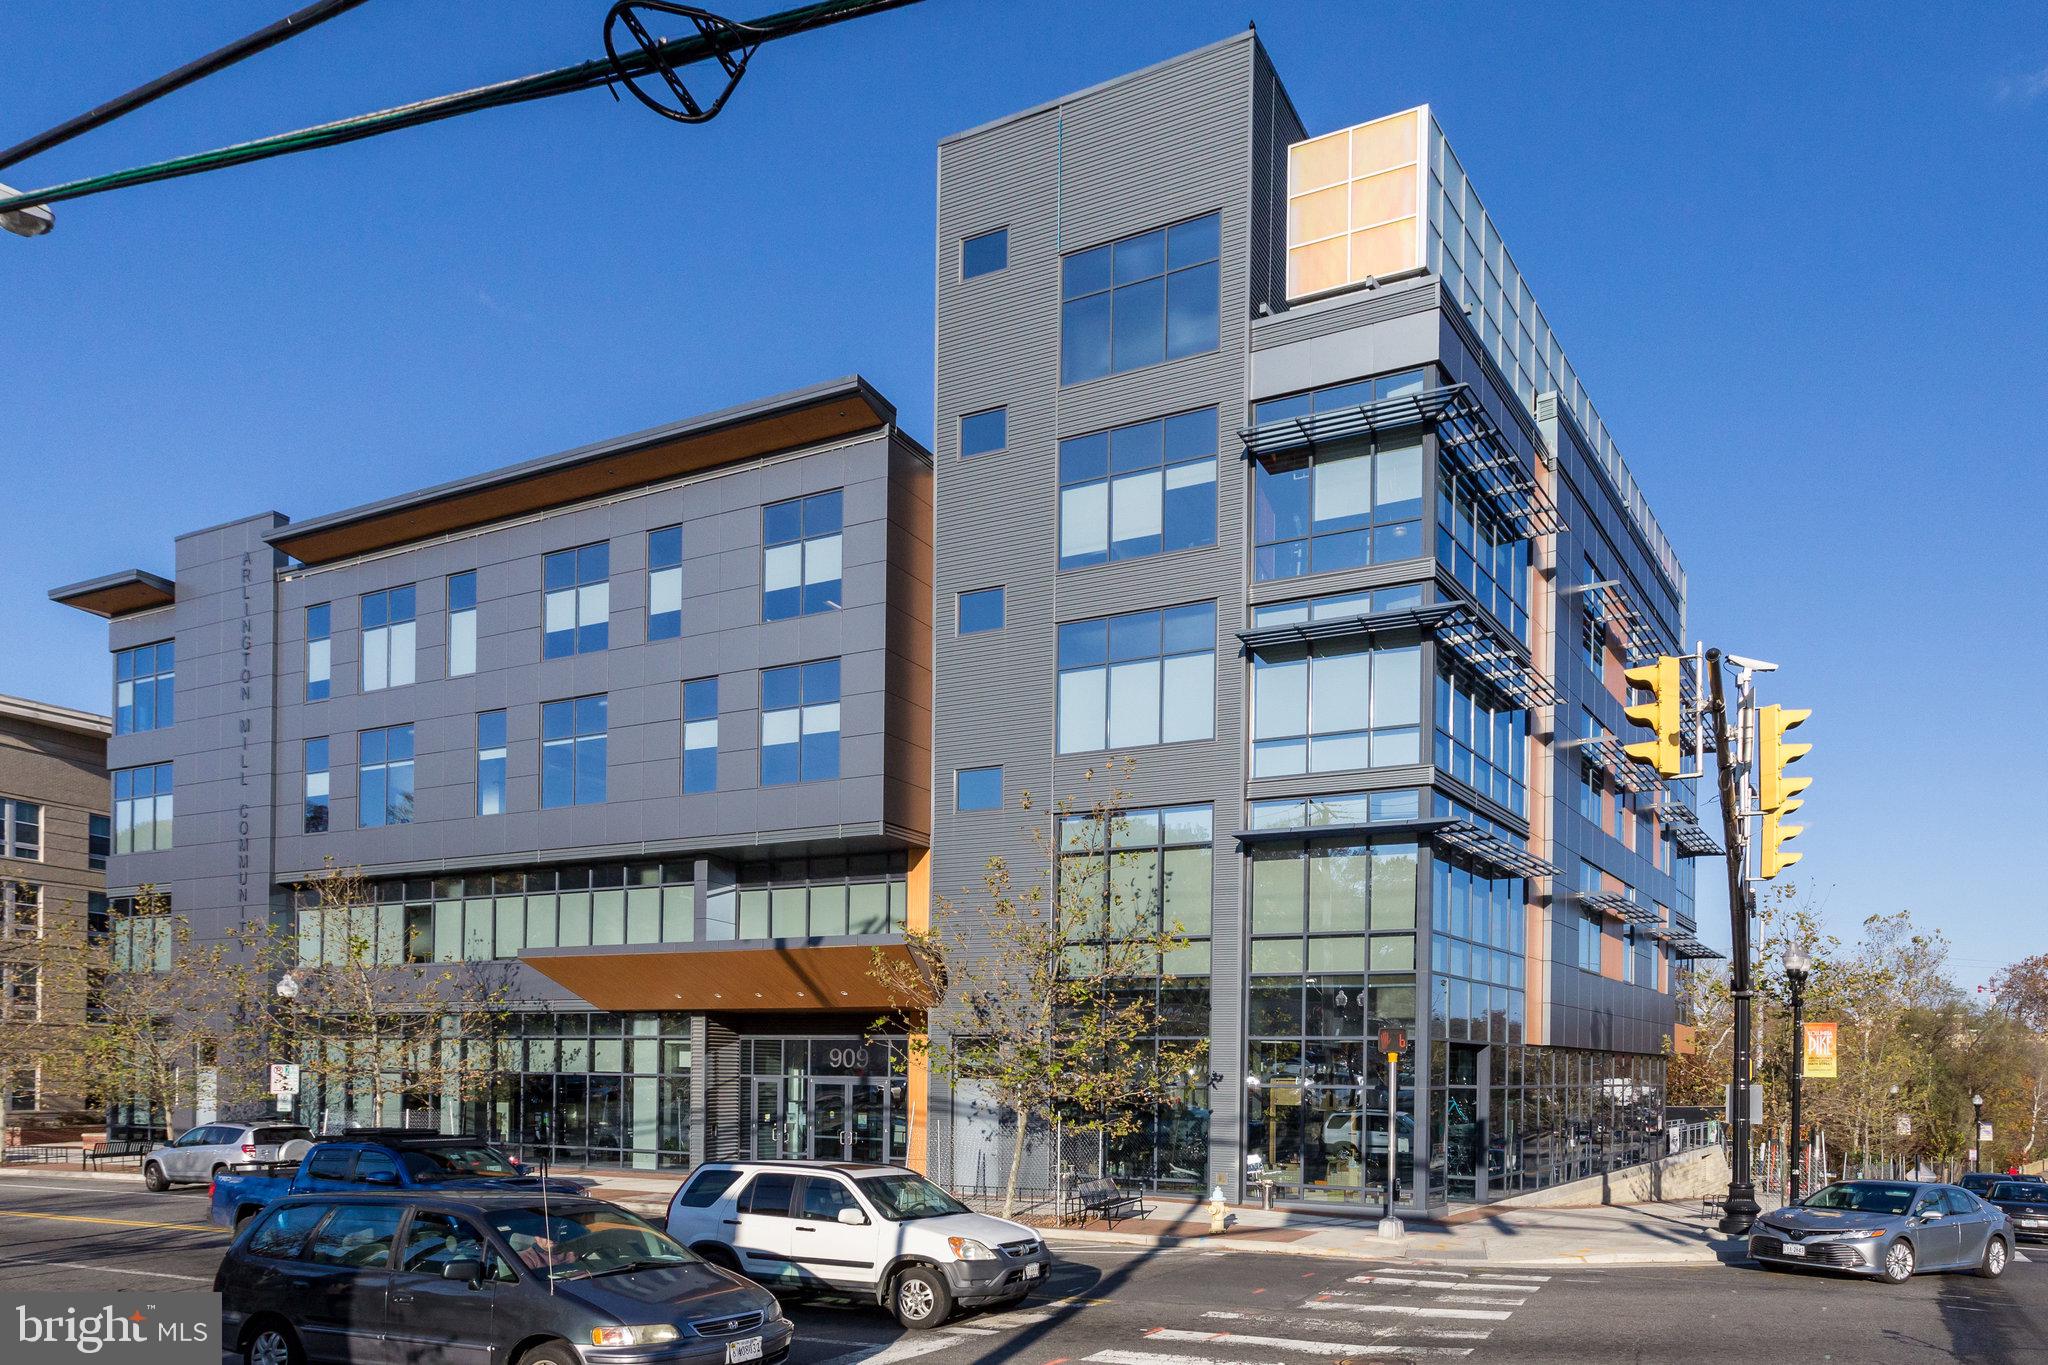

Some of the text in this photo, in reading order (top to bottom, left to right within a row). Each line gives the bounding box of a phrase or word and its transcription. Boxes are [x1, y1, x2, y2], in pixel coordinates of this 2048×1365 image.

[240, 551, 251, 700] ARLINGTON
[239, 718, 250, 786] MILL
[830, 1048, 869, 1068] 909
[1808, 1035, 1833, 1056] PIKE
